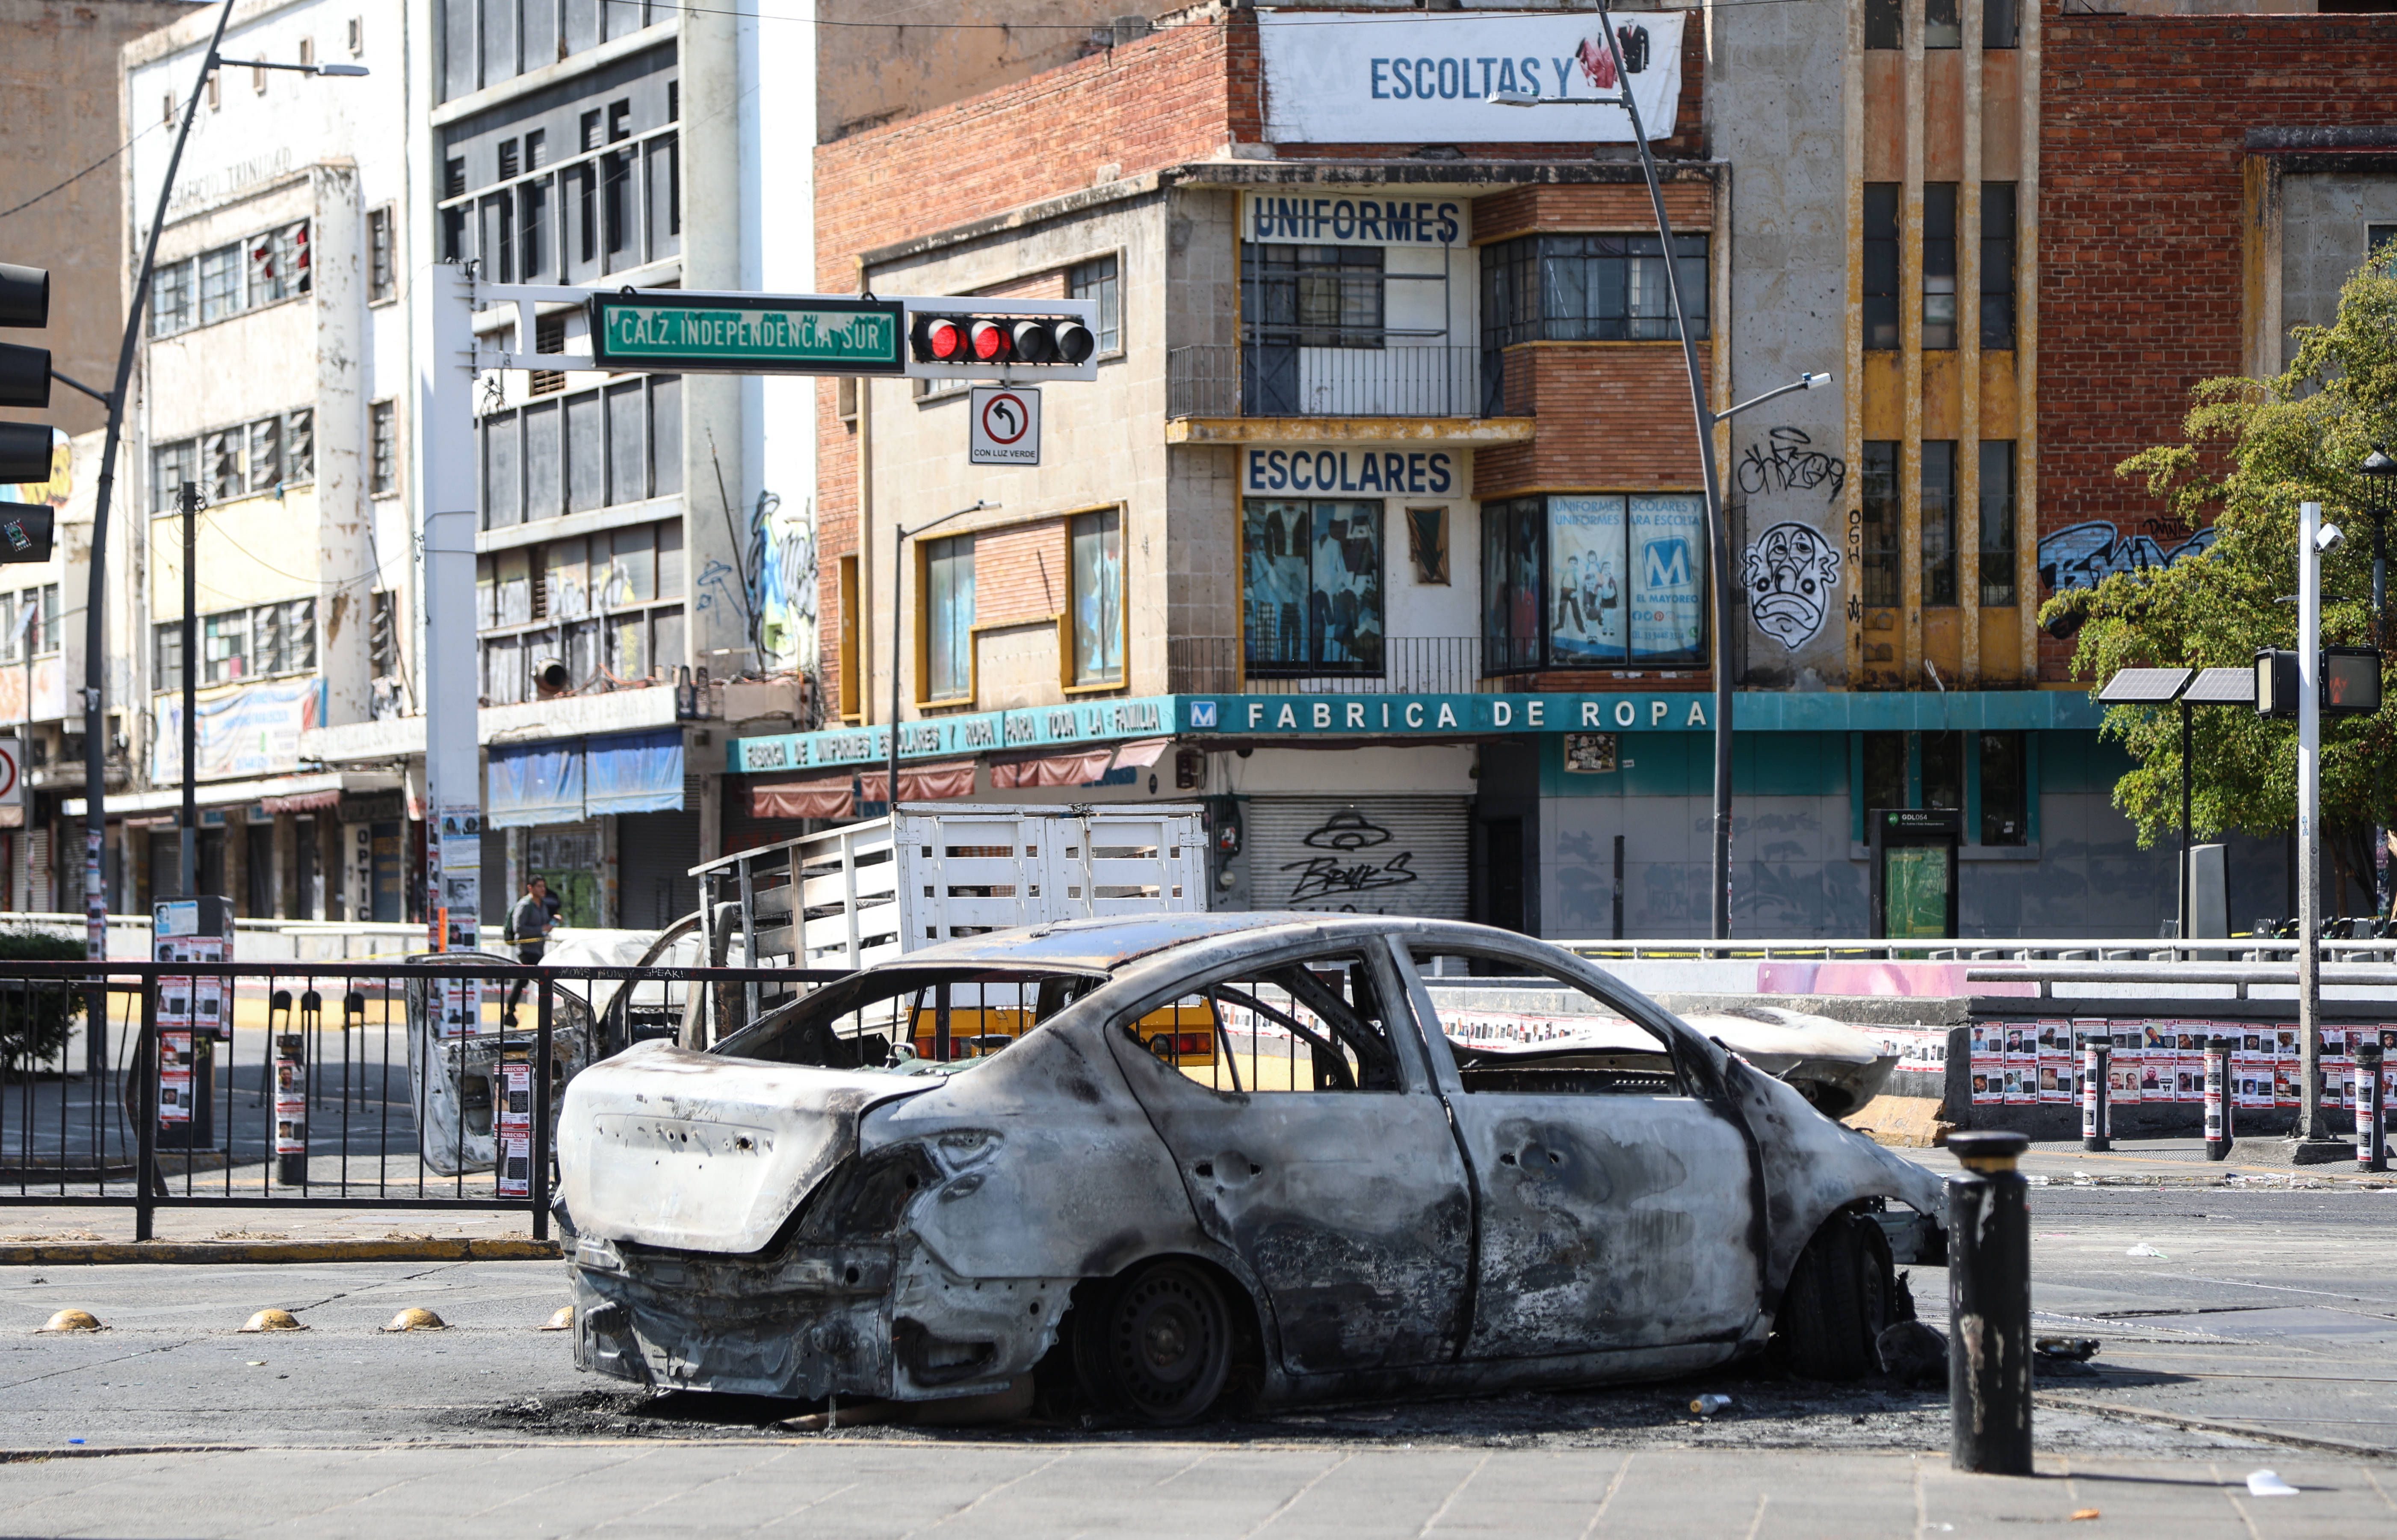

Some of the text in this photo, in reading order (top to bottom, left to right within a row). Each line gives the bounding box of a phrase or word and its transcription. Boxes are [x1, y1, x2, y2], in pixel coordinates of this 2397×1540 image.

[1371, 57, 1574, 99] ESCOLTAS Y
[1255, 197, 1459, 242] UNIFORMES
[621, 318, 676, 344] CALZ.
[680, 319, 831, 348] INDEPENDENCIA
[1249, 450, 1451, 493] ESCOLARES
[1555, 500, 1699, 512] UNIFORMES SCOLARES Y
[1555, 514, 1700, 527] UNIFORMES ARA ESCOLTA
[1636, 594, 1699, 603] EL MAYOREO
[1191, 704, 1216, 727] M
[1248, 701, 1707, 729] FABRICA DE ROPA
[794, 740, 808, 765] DE
[816, 733, 871, 763] UNIFORMES
[878, 725, 940, 759] ESOLARES
[948, 724, 957, 750] Y
[965, 719, 996, 747] ROPA
[1004, 715, 1037, 743] PARA
[1047, 710, 1078, 739] TODA
[1087, 707, 1105, 736] LA
[1114, 703, 1162, 733] FAMILIA
[358, 829, 369, 921] OPTIC
